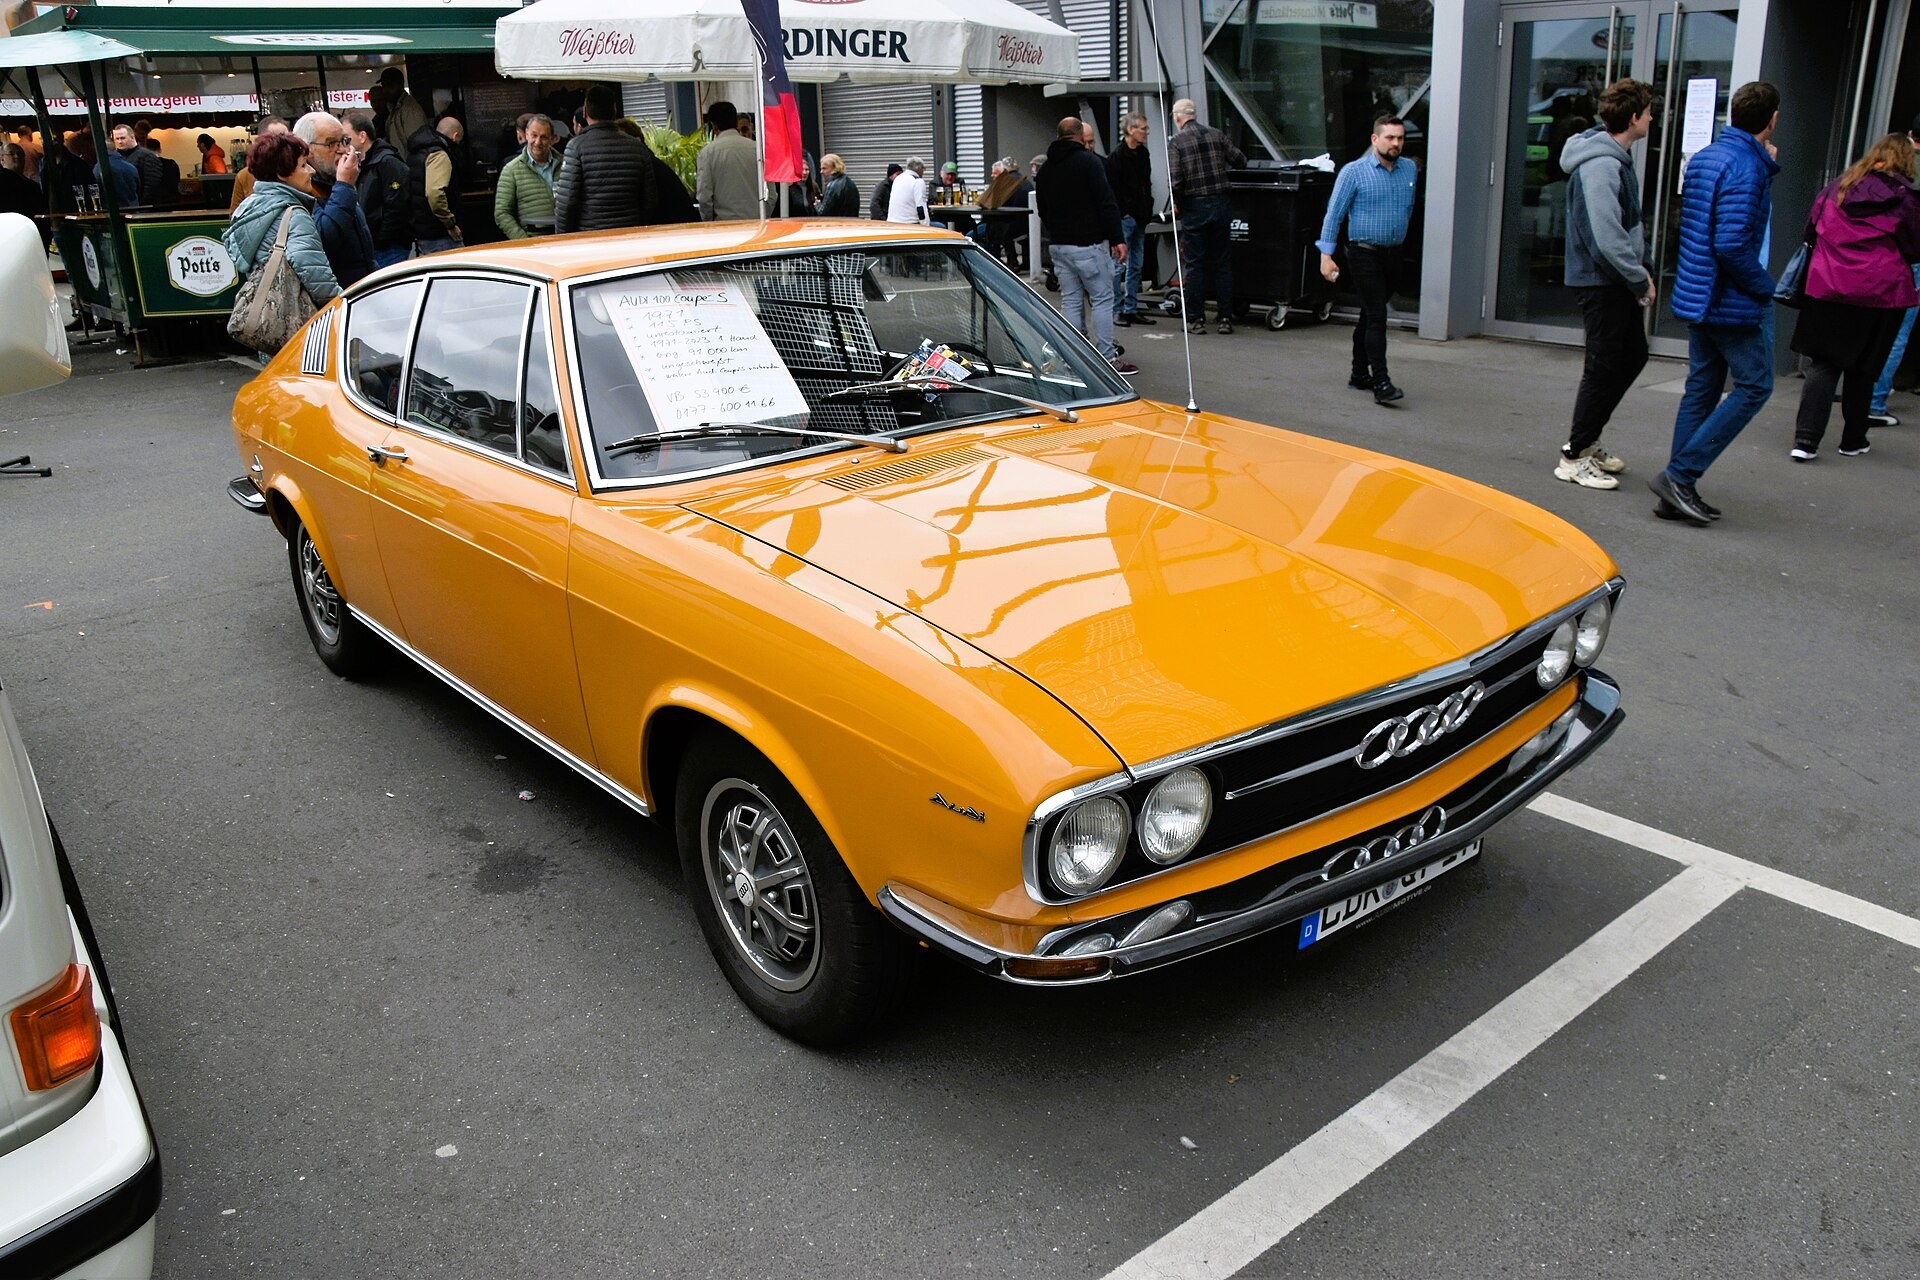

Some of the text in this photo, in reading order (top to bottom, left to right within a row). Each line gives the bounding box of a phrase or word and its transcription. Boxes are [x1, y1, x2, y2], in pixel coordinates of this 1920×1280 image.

[559, 28, 636, 62] Weißbier
[780, 28, 911, 62] RDINGER
[998, 34, 1044, 68] Weißbier
[177, 256, 221, 280] Pott's
[619, 294, 649, 307] AUDI
[652, 295, 671, 305] 100
[716, 292, 728, 304] S
[642, 309, 684, 321] 1971
[649, 318, 701, 329] 115 PS
[730, 333, 757, 342] Hand
[688, 347, 702, 356] 91
[707, 347, 728, 355] 000
[667, 384, 752, 403] VB 53 900 €
[676, 404, 706, 420] 0177
[720, 401, 742, 413] 600
[744, 399, 757, 409] 11
[761, 397, 776, 408] 66
[929, 792, 986, 823] Audi
[1304, 924, 1313, 938] D
